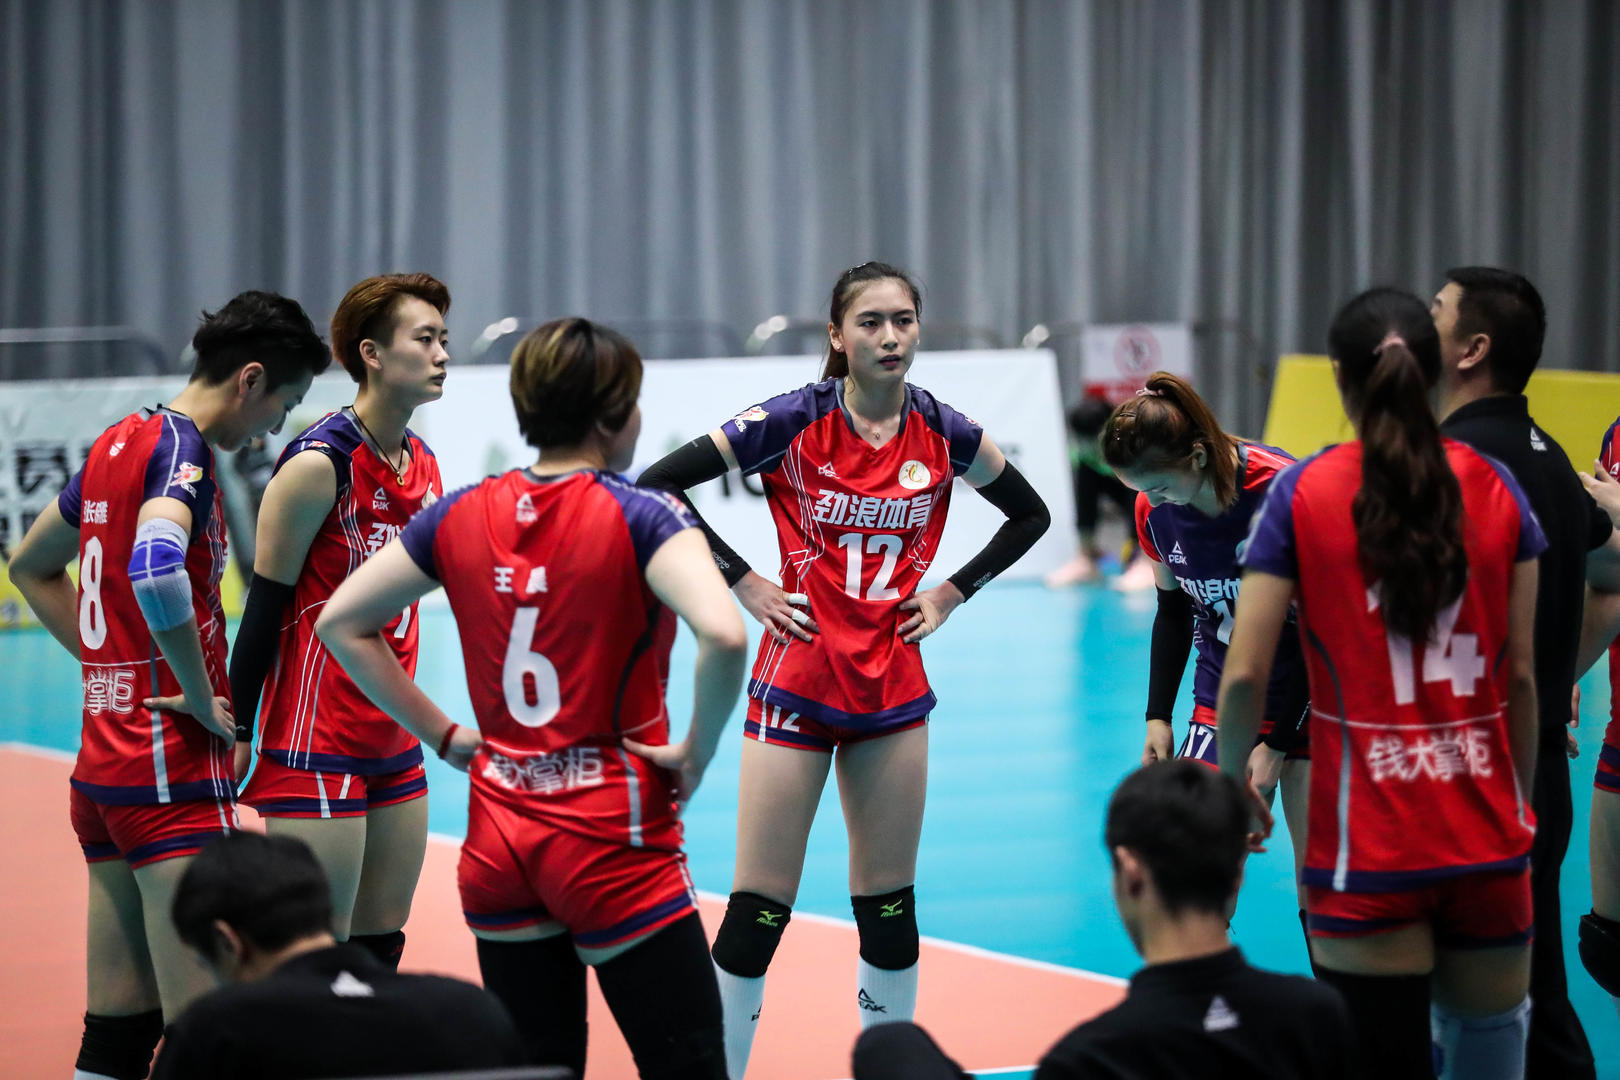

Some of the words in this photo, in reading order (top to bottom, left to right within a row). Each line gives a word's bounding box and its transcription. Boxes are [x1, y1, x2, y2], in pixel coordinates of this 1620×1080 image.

[812, 488, 932, 529] 劲浪体育
[838, 532, 903, 601] 12
[1168, 554, 1188, 566] PEAK
[79, 536, 107, 650] 8
[503, 606, 561, 728] 6
[1366, 578, 1486, 706] 14
[770, 705, 801, 732] 12
[1183, 723, 1216, 760] 17
[1367, 728, 1493, 782] 钱大掌柜
